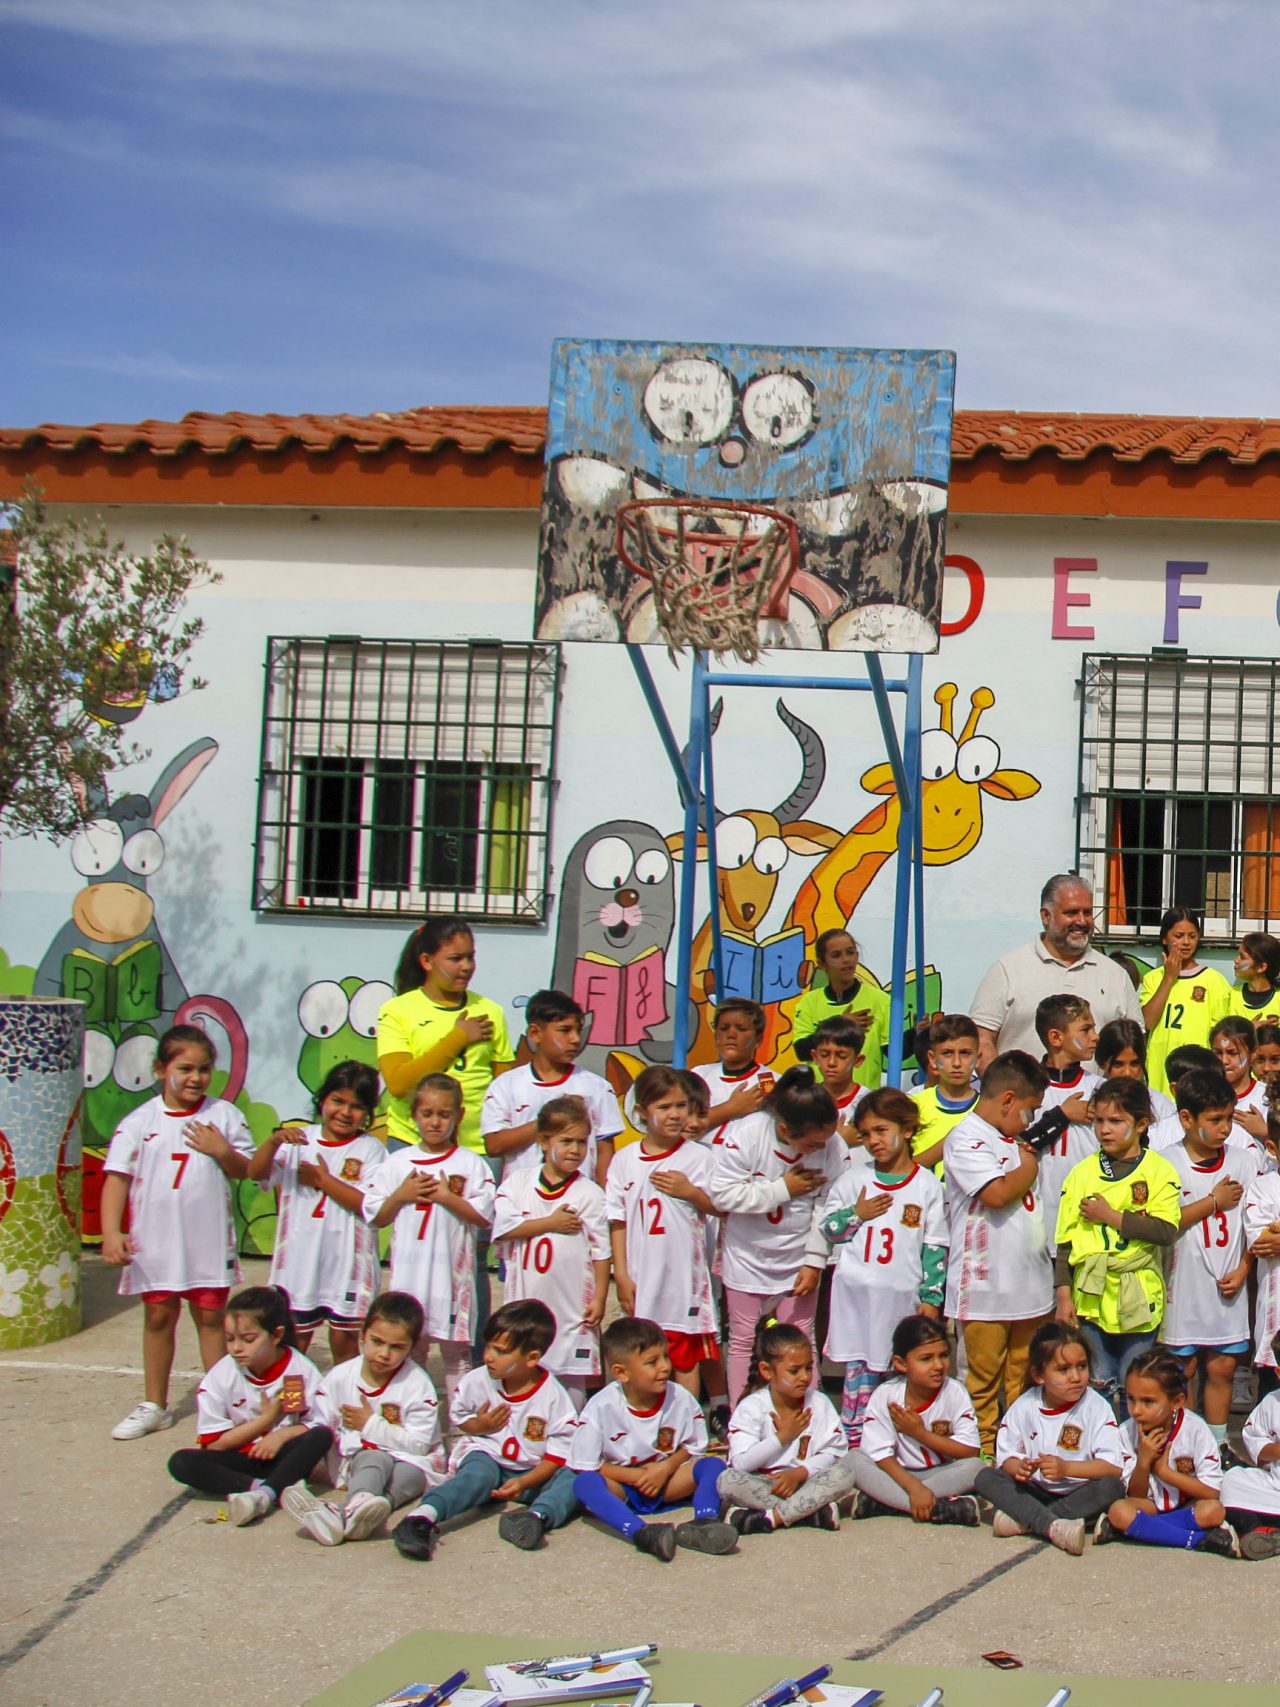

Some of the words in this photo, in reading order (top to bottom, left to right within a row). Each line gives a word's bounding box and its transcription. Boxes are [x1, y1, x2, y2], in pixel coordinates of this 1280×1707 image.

[939, 554, 985, 636] D
[1052, 558, 1097, 640] E
[1163, 560, 1209, 644] F
[73, 966, 94, 1009] B
[126, 963, 151, 1007] b
[722, 950, 744, 992] I
[770, 955, 793, 989] i
[586, 976, 608, 1012] F
[635, 966, 652, 1020] f
[1164, 1003, 1185, 1029] 12
[171, 1153, 190, 1190] 7
[415, 1202, 433, 1241] 7
[639, 1198, 666, 1236] 12
[1202, 1210, 1231, 1249] 13
[522, 1237, 554, 1274] 10
[863, 1226, 895, 1266] 13
